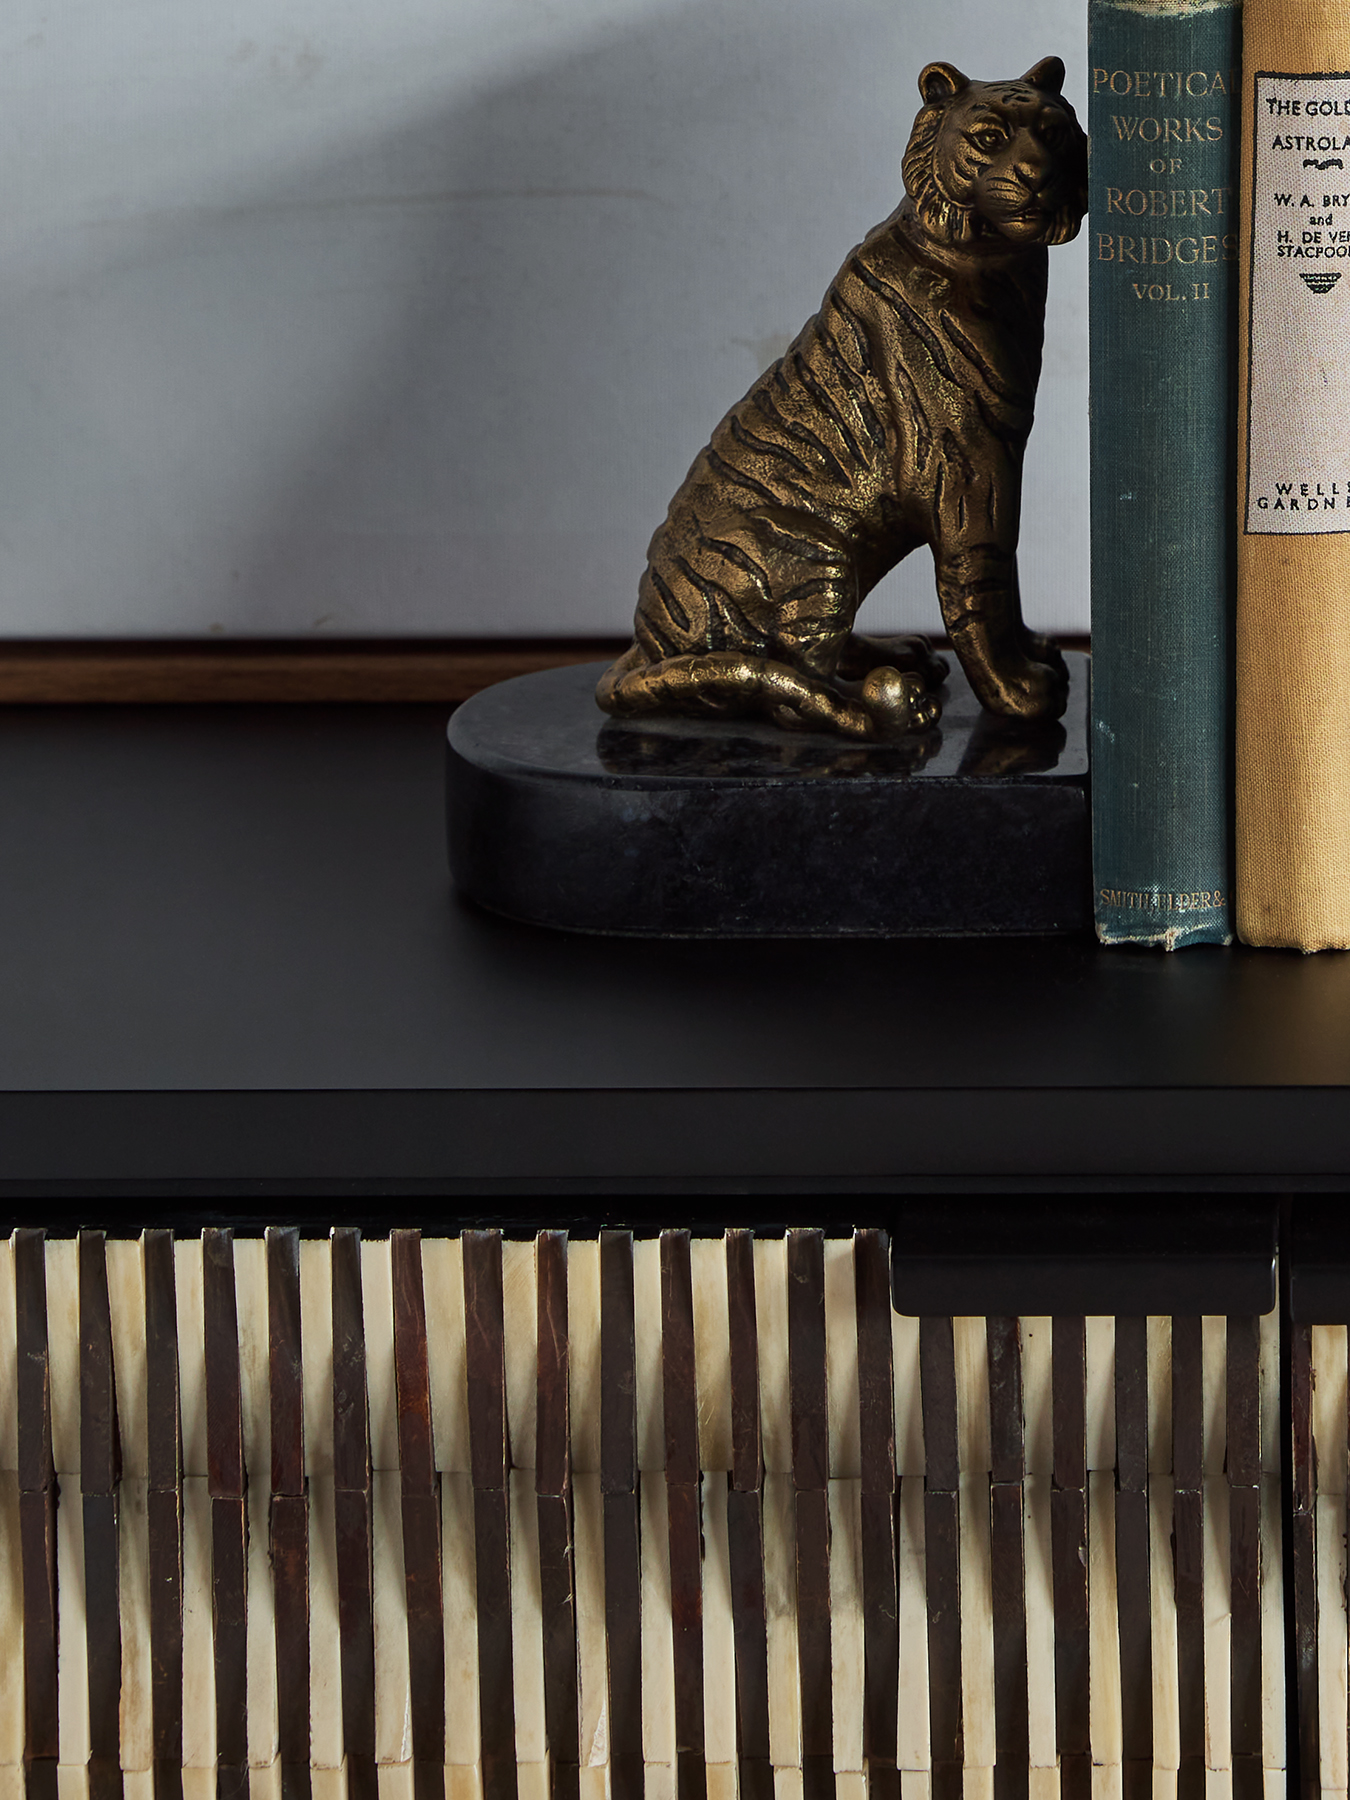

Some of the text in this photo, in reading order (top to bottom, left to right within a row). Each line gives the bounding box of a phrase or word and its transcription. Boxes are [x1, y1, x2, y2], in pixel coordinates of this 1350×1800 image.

[1266, 96, 1300, 116] THE
[1112, 116, 1224, 143] WORKS
[1150, 158, 1183, 175] OF
[1106, 187, 1232, 217] ROBERT
[1274, 193, 1295, 208] W.
[1300, 193, 1315, 208] A.
[1309, 213, 1333, 226] and
[1277, 230, 1293, 244] H.
[1302, 230, 1322, 244] DE
[1097, 232, 1238, 265] BRIDGES
[1132, 282, 1210, 301] VOL. II
